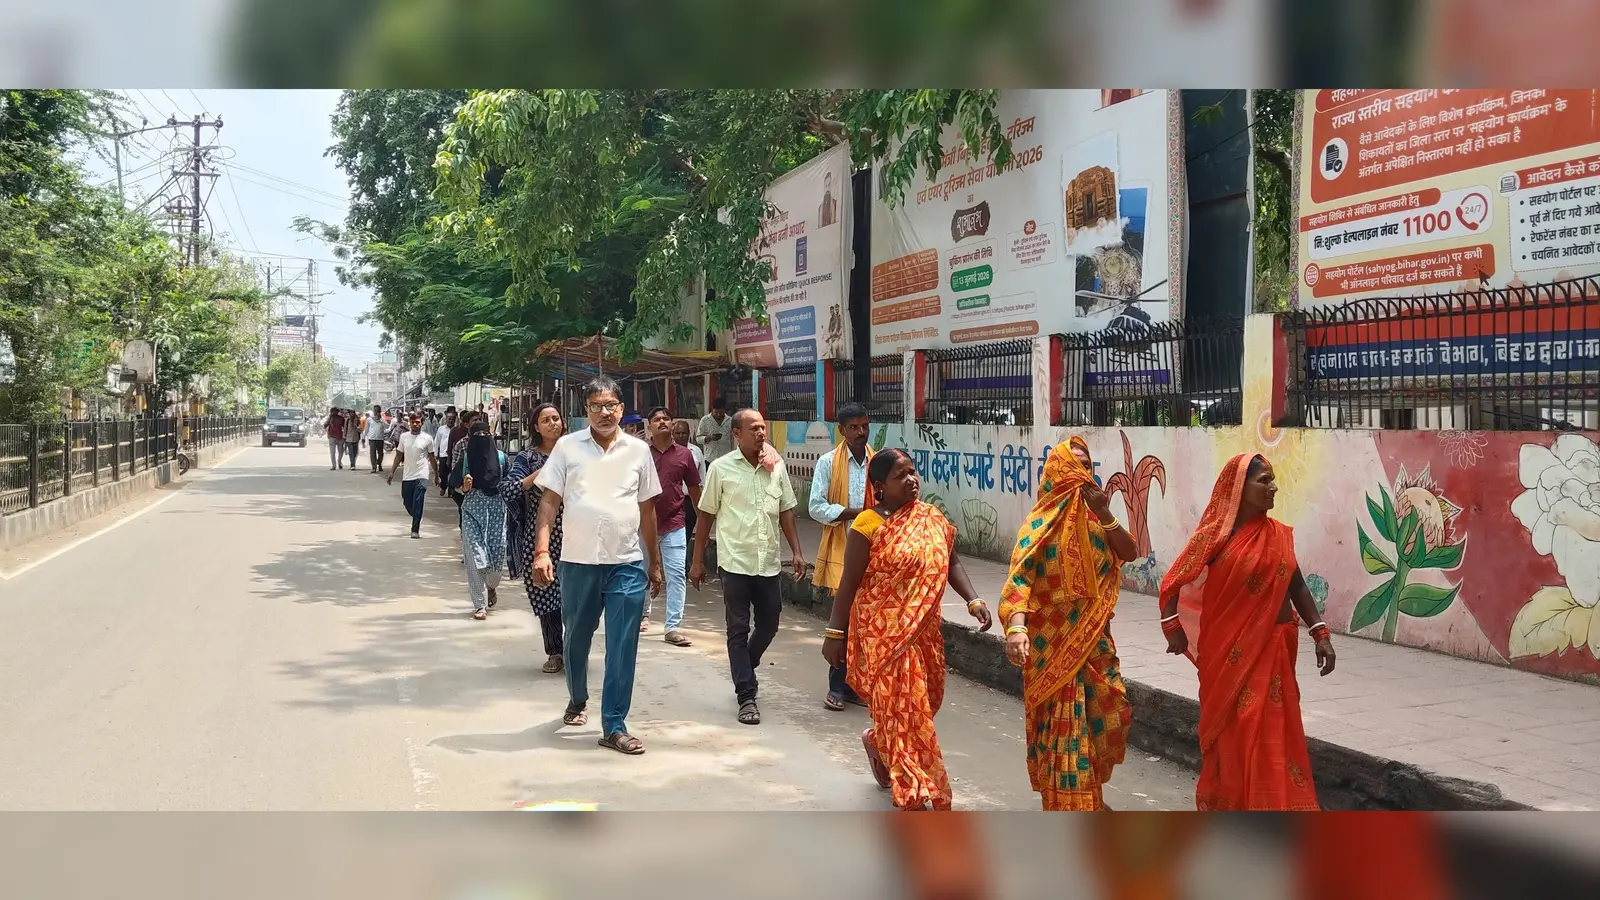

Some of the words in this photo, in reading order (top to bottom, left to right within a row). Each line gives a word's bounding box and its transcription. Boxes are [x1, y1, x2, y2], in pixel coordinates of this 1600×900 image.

[1331, 110, 1356, 129] राज्य
[1357, 98, 1392, 121] स्तरीय
[1359, 131, 1372, 145] वैसे
[1373, 122, 1406, 141] आवेदकों
[1408, 119, 1417, 131] के
[1419, 115, 1436, 129] लिए
[1438, 107, 1463, 124] विशेष
[1358, 141, 1394, 162] शिकायतों
[1395, 140, 1407, 152] का
[1409, 133, 1432, 148] जिला
[1433, 129, 1450, 142] स्तर
[1452, 126, 1465, 138] पर
[1555, 97, 1567, 112] के
[967, 165, 984, 186] सेवा
[986, 159, 1013, 178] योना
[1016, 145, 1043, 169] 2026
[1358, 161, 1382, 178] अंतर्गत
[1384, 155, 1414, 172] अपेक्षित
[1416, 145, 1453, 164] निस्तारण
[1456, 138, 1473, 154] नहीं
[1474, 136, 1485, 151] हो
[1487, 132, 1511, 147] सका
[1513, 127, 1521, 143] है
[1526, 168, 1562, 184] आवेदन
[1564, 161, 1586, 177] कैसे
[1308, 213, 1328, 226] सहयोग
[1328, 209, 1346, 222] शिविर
[1346, 208, 1353, 218] से
[1354, 203, 1377, 217] संबंधित
[1378, 195, 1408, 211] जानकारी
[1408, 193, 1420, 207] हेतु
[1465, 204, 1481, 215] 24/7
[1529, 191, 1558, 206] सहयोग
[1559, 186, 1582, 201] पोर्टल
[1583, 185, 1597, 197] पर
[1343, 226, 1379, 244] हेल्पलाइन
[1379, 222, 1399, 237] नंबर
[1403, 210, 1451, 237] 1100
[1529, 211, 1541, 228] पूर्व
[1542, 209, 1552, 222] में
[1552, 207, 1566, 221] दिए
[1568, 204, 1582, 218] गये
[1530, 228, 1557, 243] रेफरेंस
[1558, 226, 1578, 239] नंबर
[1580, 224, 1592, 236] का
[1325, 267, 1346, 280] सहयोग
[1347, 264, 1364, 276] पोर्टल
[1365, 252, 1450, 275] (sahyog.bihar.gov.in)
[1452, 251, 1462, 262] पर
[1464, 246, 1483, 259] कभी
[1531, 246, 1560, 261] चयनित
[1562, 240, 1595, 257] आवेदकों
[977, 271, 989, 281] 2026
[1340, 279, 1349, 290] भी
[1350, 276, 1380, 289] ऑनलाइन
[1381, 272, 1405, 285] परिवाद
[1405, 269, 1418, 283] दर्ज
[1419, 270, 1432, 280] कर
[1434, 265, 1455, 278] सकते
[932, 450, 960, 491] कदम
[963, 441, 995, 491] स्मार्ट
[1000, 443, 1033, 497] सिटी
